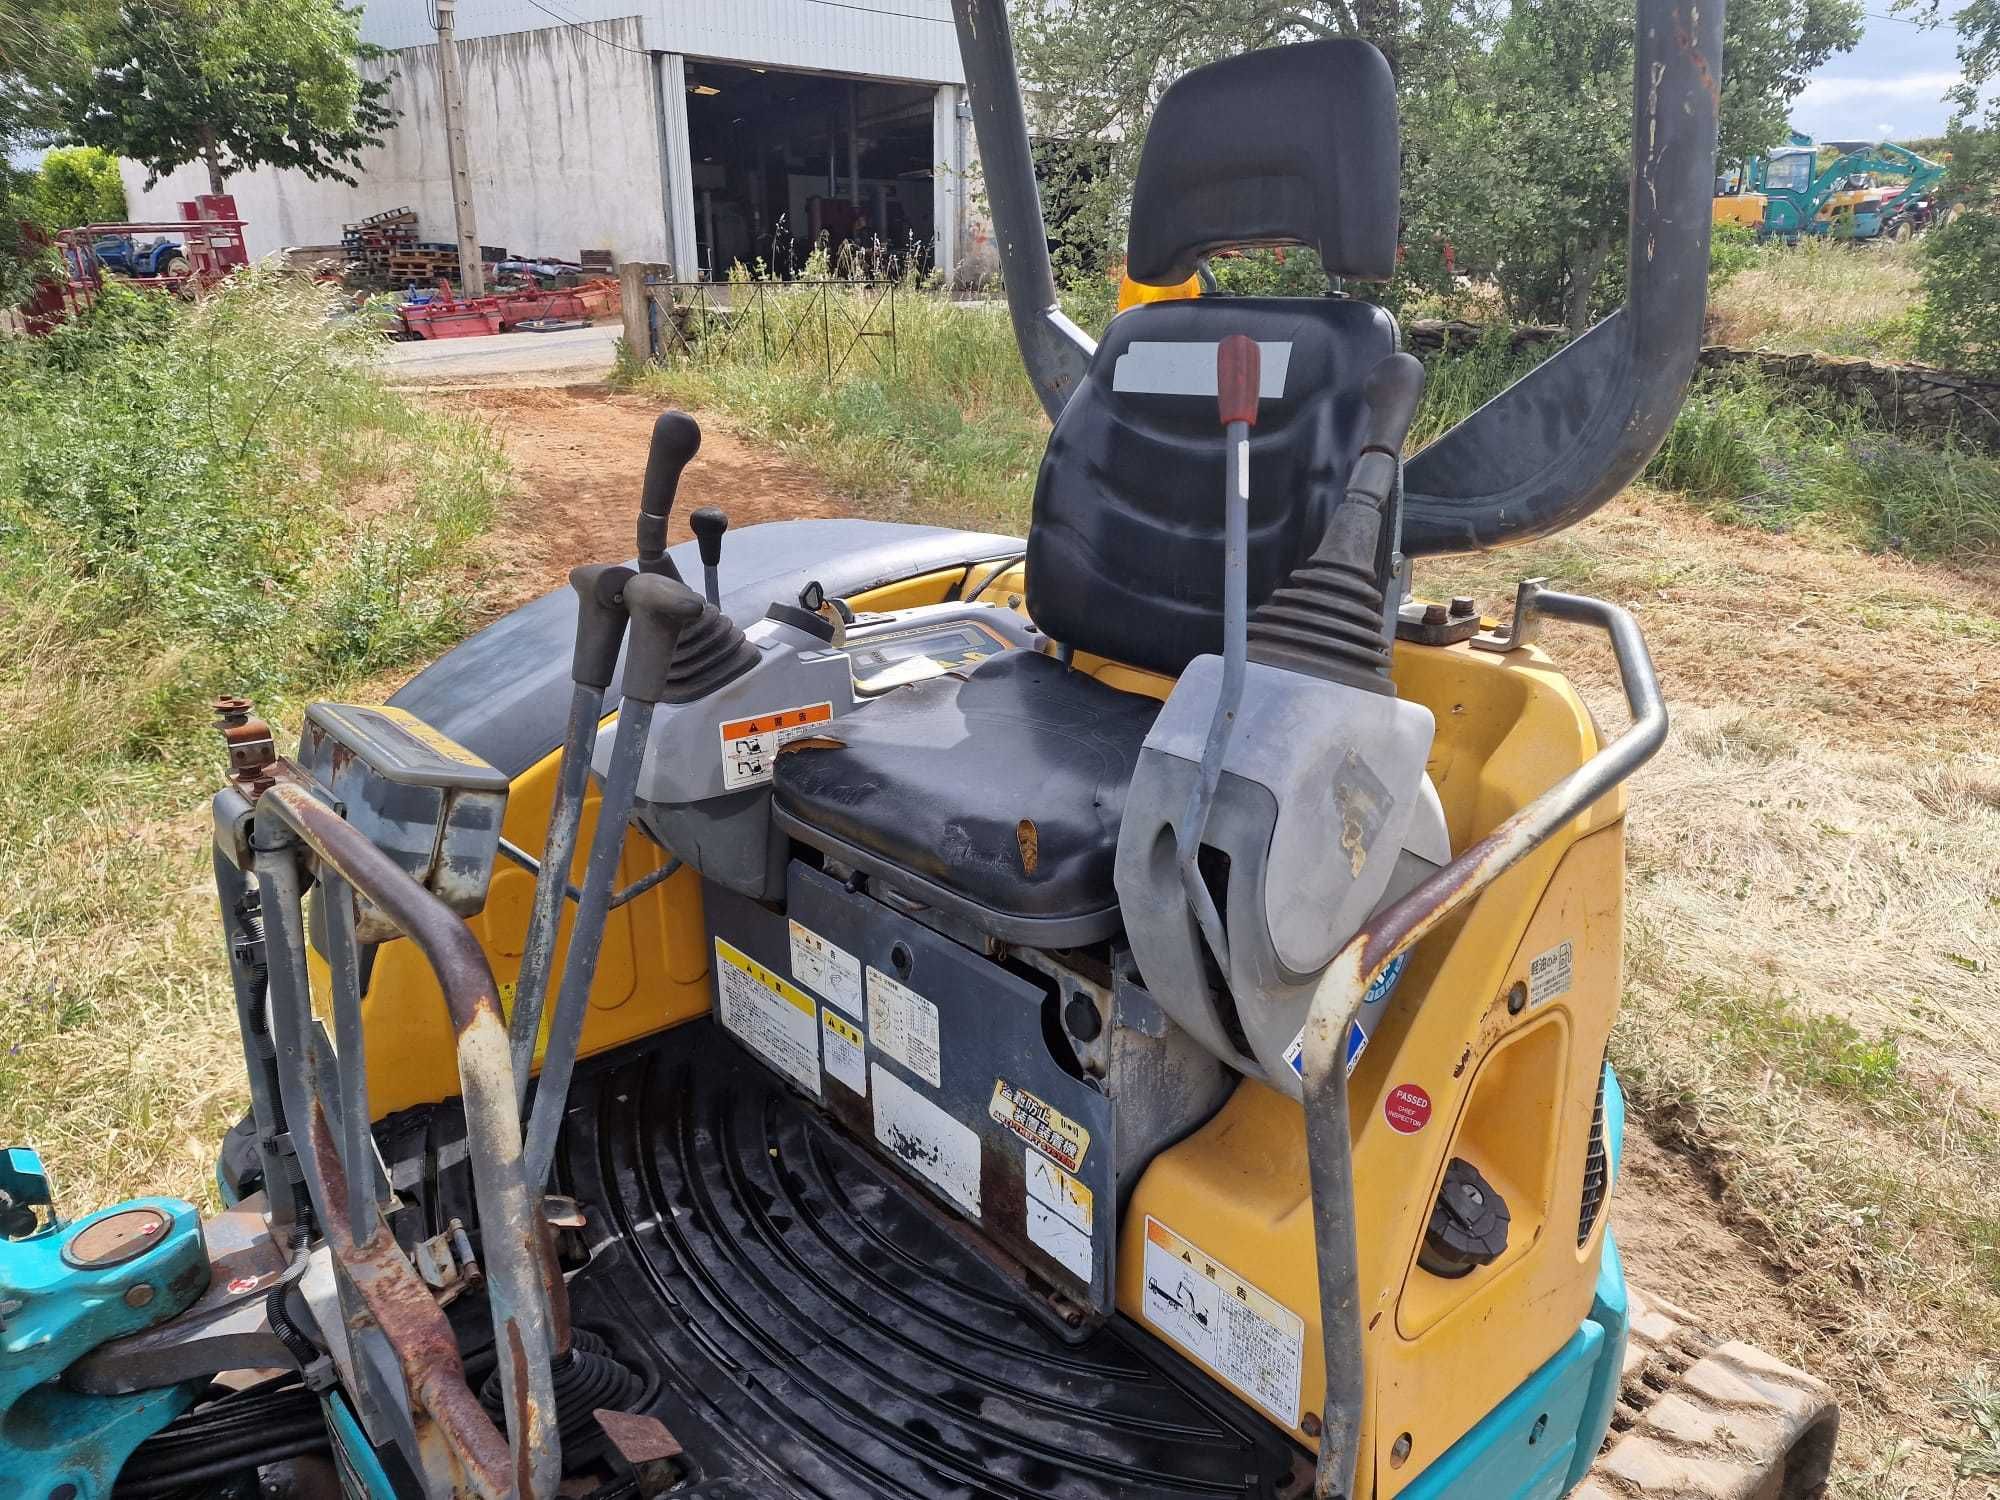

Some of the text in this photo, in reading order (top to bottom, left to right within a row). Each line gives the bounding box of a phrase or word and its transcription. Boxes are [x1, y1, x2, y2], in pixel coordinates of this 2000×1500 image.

[1397, 1090, 1428, 1108] PASSED
[1388, 1110, 1422, 1128] INSPECTOR
[1398, 1106, 1416, 1116] CHIEF
[1014, 1109, 1078, 1158] 装置装着機
